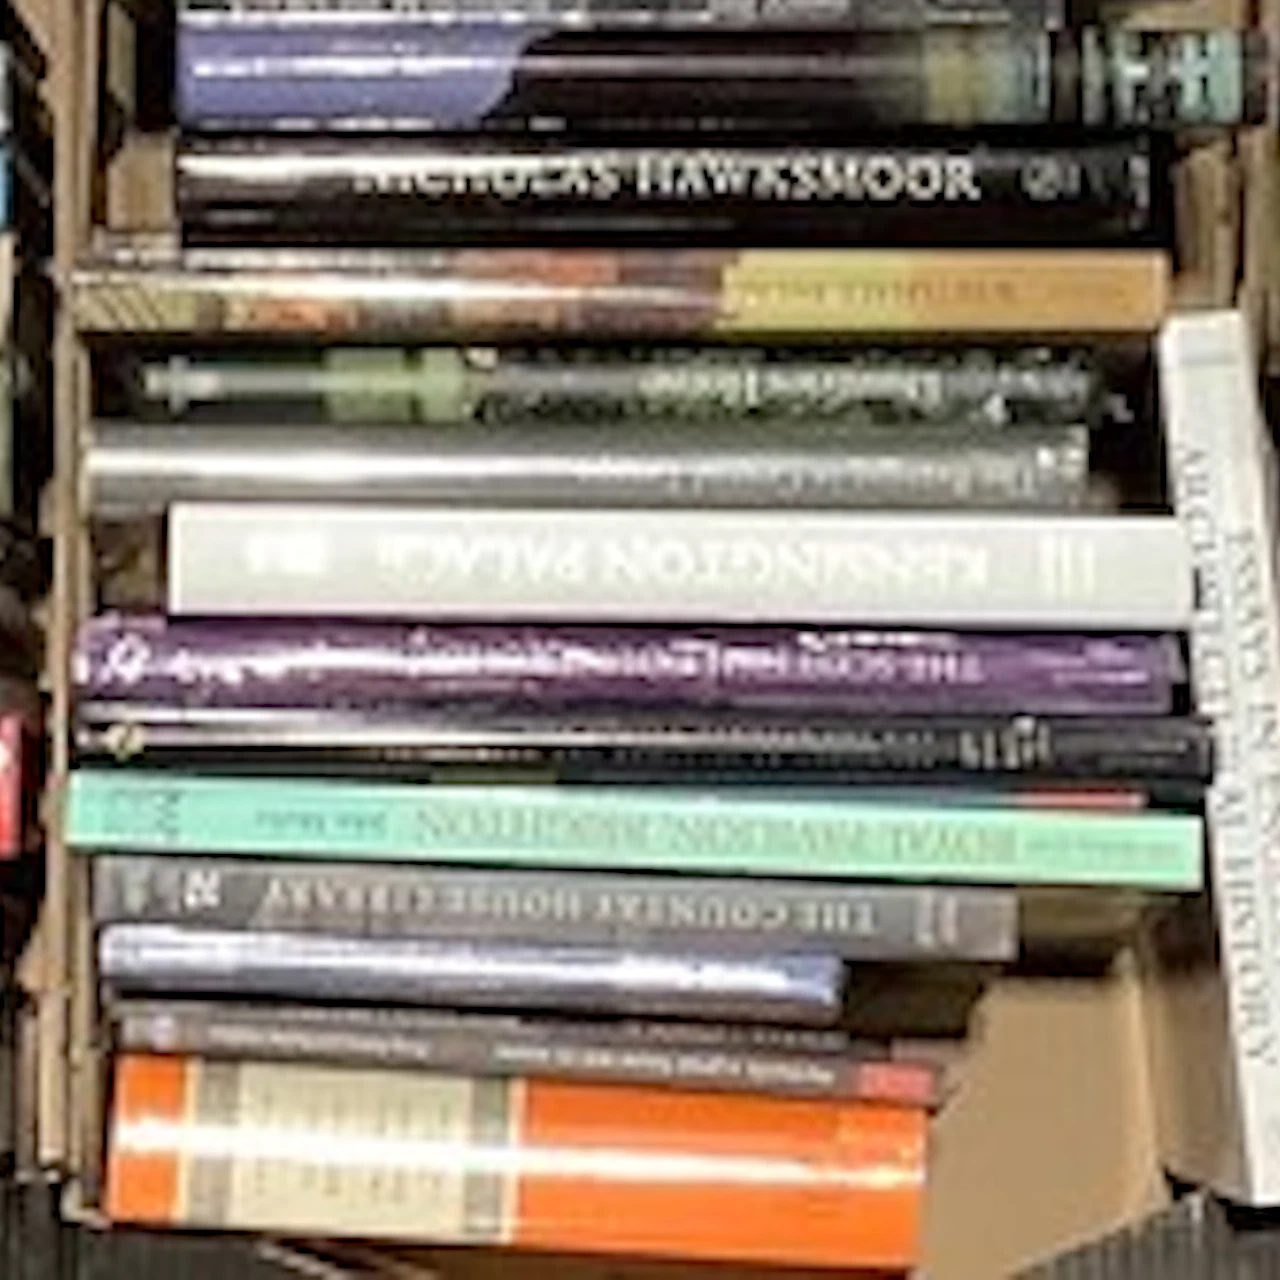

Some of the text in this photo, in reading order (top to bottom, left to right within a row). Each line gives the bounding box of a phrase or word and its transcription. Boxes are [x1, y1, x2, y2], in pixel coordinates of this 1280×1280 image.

[636, 155, 983, 203] HAWKSMOOR
[600, 538, 990, 590] KENSINGTON
[1222, 529, 1271, 682] ESSAYS
[1248, 703, 1279, 746] IN
[263, 877, 877, 936] THE COUNTRY HOUSE LIBRARY
[1215, 856, 1279, 1070] HISTORY
